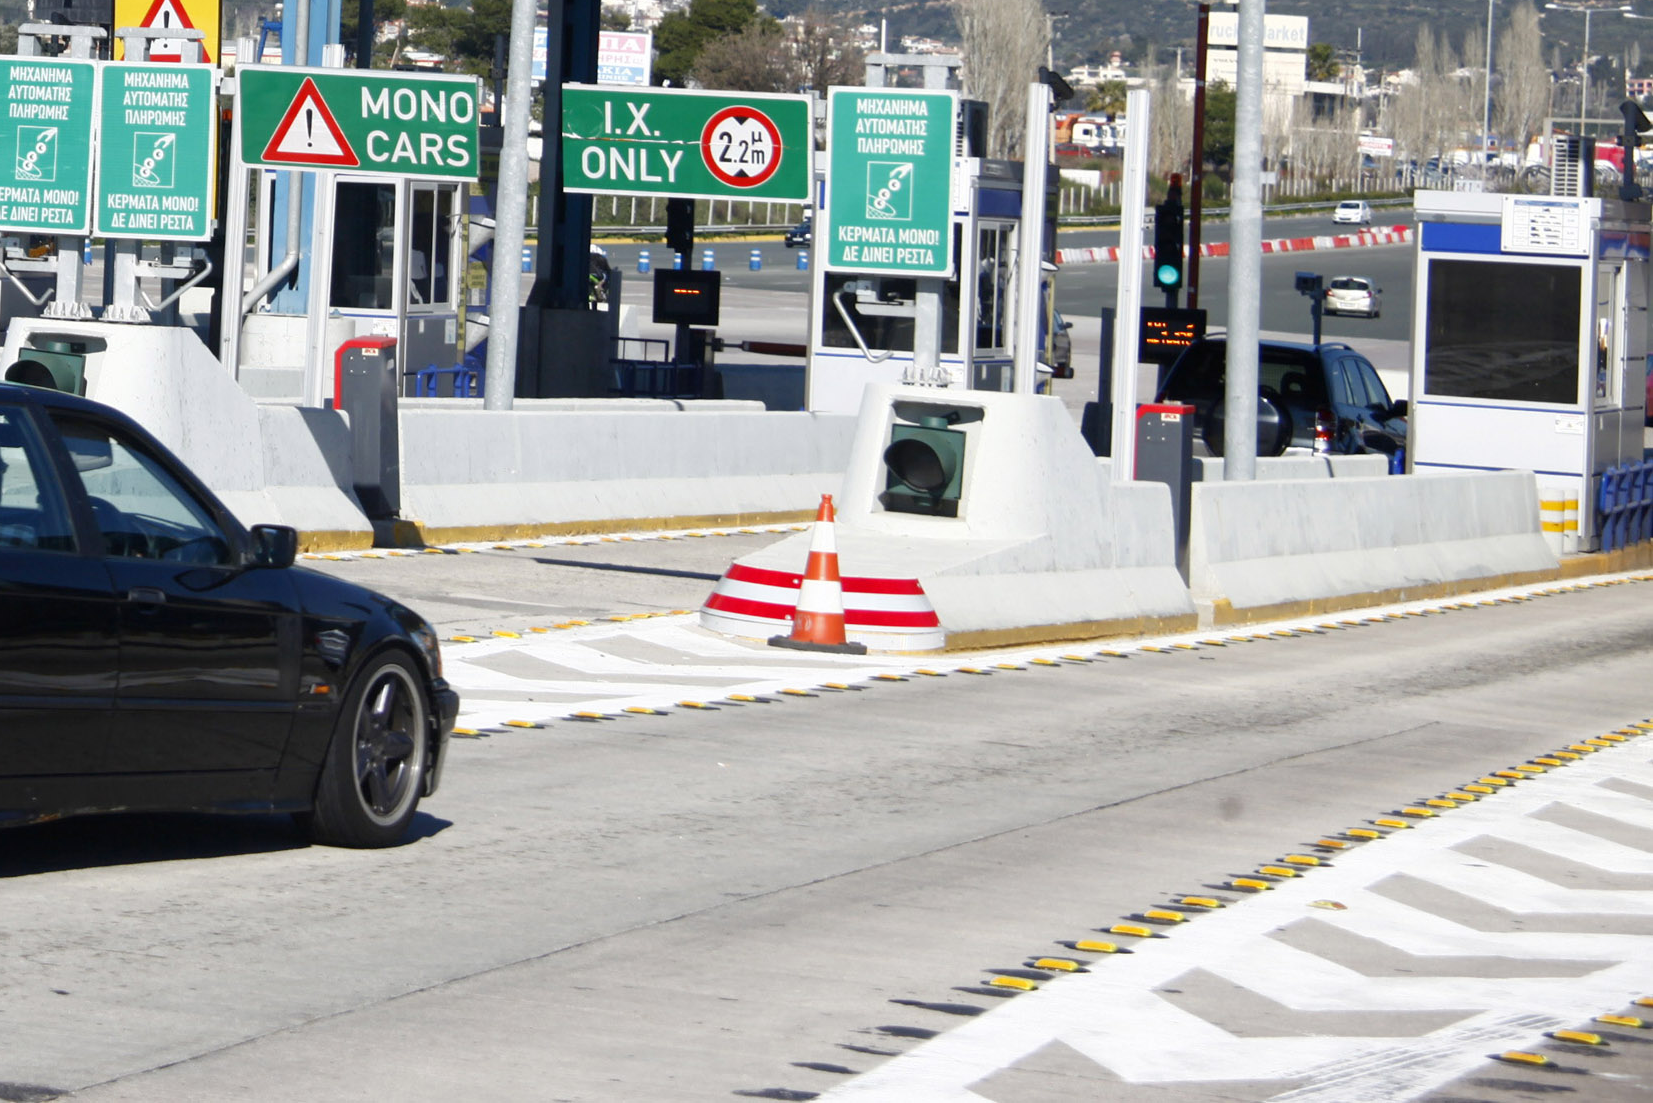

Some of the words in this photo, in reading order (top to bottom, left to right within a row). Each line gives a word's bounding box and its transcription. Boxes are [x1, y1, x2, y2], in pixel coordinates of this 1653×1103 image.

[1264, 25, 1305, 42] arket
[10, 66, 73, 83] ΜΗΧΑΝΗΜΑ
[124, 72, 189, 89] ΜΗΧΑΝΗΜΑ
[8, 85, 72, 102] ΑΥΤΟΜΑΤΗΣ
[123, 91, 189, 108] ΑΥΤΟΜΑΤΗΣ
[9, 103, 69, 120] ΠΛΗΡΩΜΗΣ
[856, 98, 928, 116] ΜΗΧΑΝΗΜΑ
[125, 109, 186, 126] ΠΛΗΡΩΜΗΣ
[855, 118, 928, 136] ΑΥΤΟΜΑΤΗΣ
[366, 130, 470, 167] CARS
[857, 138, 925, 155] ΠΛΗΡΩΜΗΣ
[581, 146, 684, 183] ONLY
[107, 194, 159, 210] ΚΕΡΜΑΤΑ
[10, 206, 38, 222] ΔΙΝΕΙ
[41, 208, 73, 224] ΡΕΣΤΑ
[111, 213, 127, 228] ΔΕ
[128, 213, 157, 229] ΔΙΝΕΙ
[160, 215, 194, 230] ΡΕΣΤΑ
[838, 226, 896, 243] ΚΕΡΜΑΤΑ
[842, 246, 859, 262] ΔΕ
[861, 246, 893, 263] ΔΙΝΕΙ
[897, 248, 934, 265] ΡΕΣΤΑ
